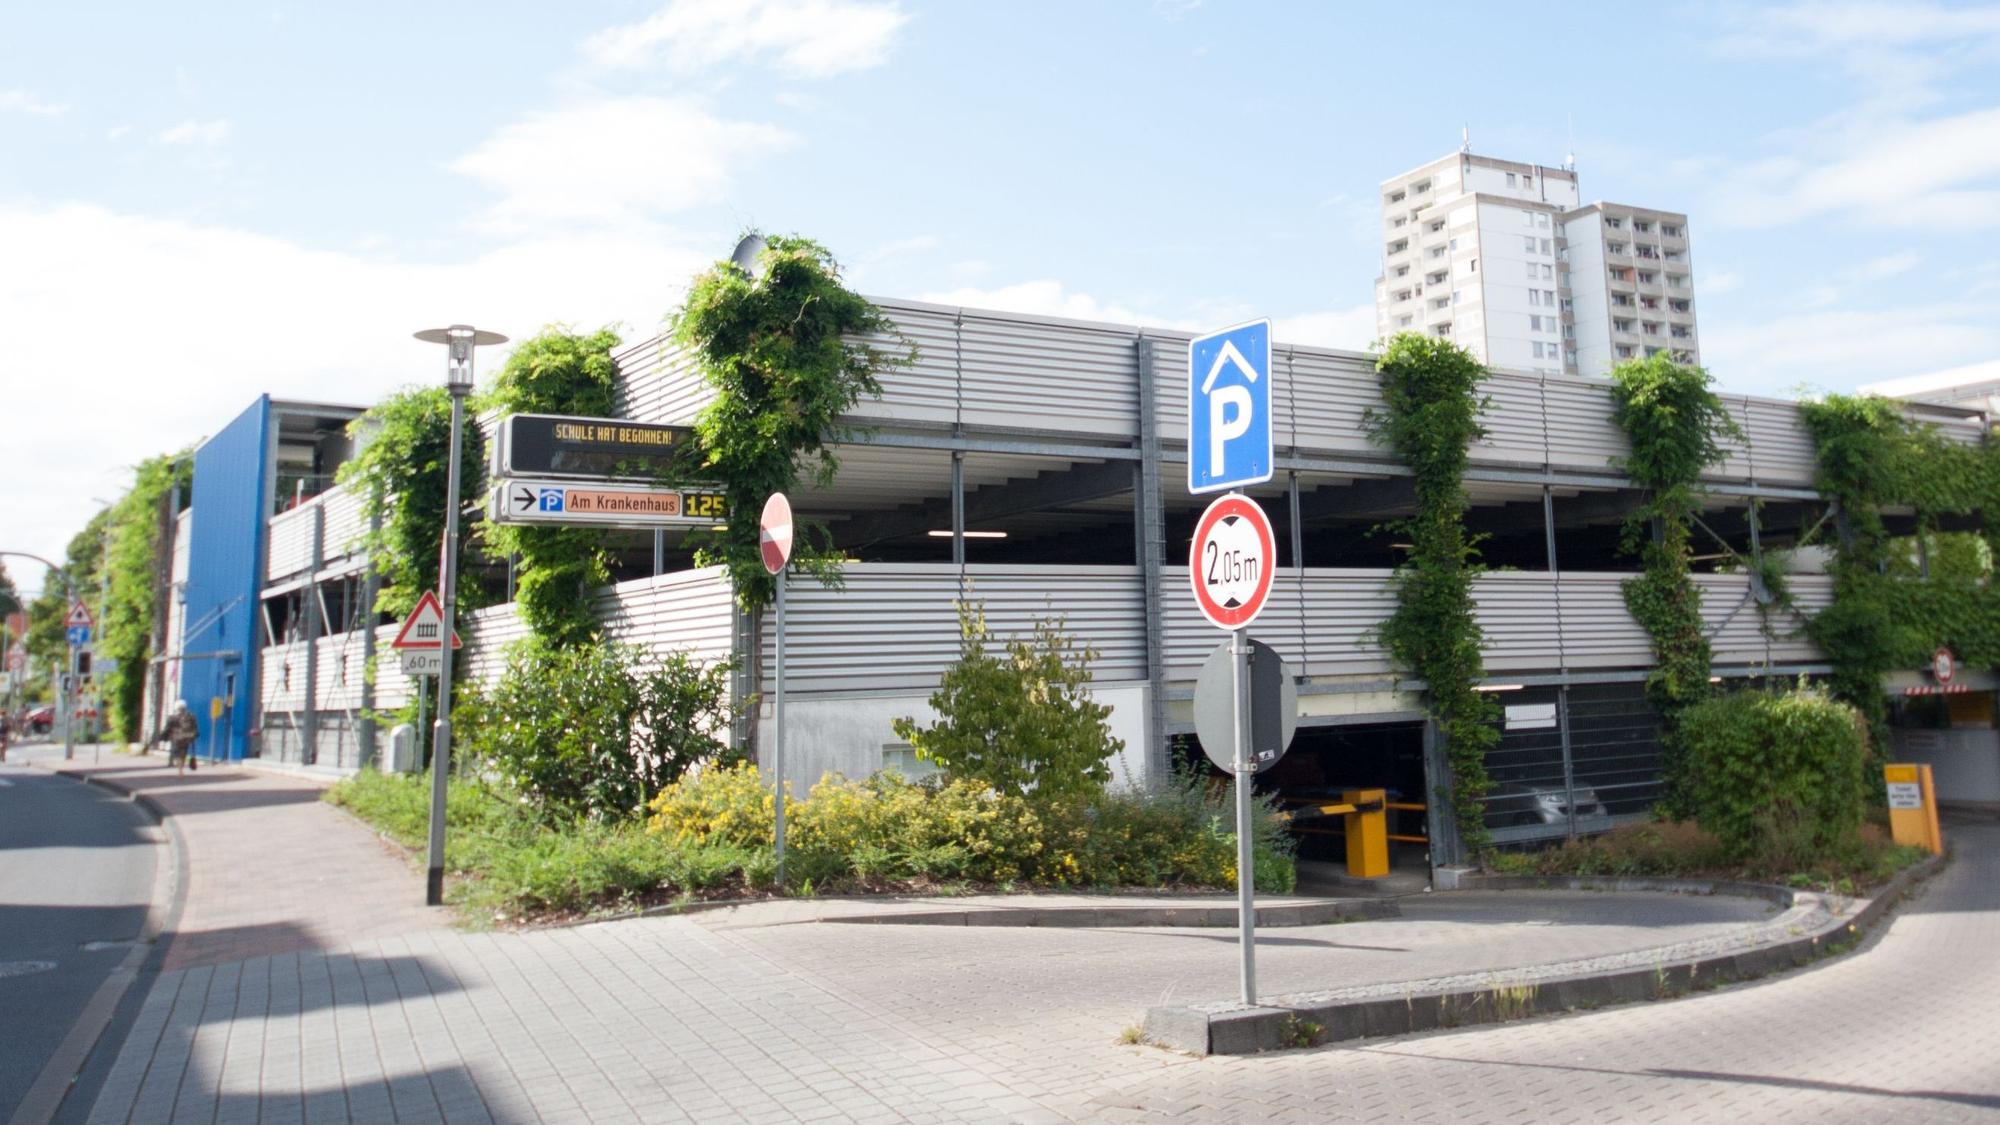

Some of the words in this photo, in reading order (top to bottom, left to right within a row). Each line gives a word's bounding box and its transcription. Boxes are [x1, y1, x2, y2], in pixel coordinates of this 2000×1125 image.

[555, 424, 594, 440] SCHULE
[597, 426, 616, 442] HAT
[619, 428, 672, 445] BEGONNEN!
[1209, 384, 1253, 478] P
[546, 495, 558, 511] P
[570, 494, 591, 509] Am
[597, 495, 675, 512] Krankenhaus
[686, 495, 725, 517] 125
[409, 656, 426, 669] 60
